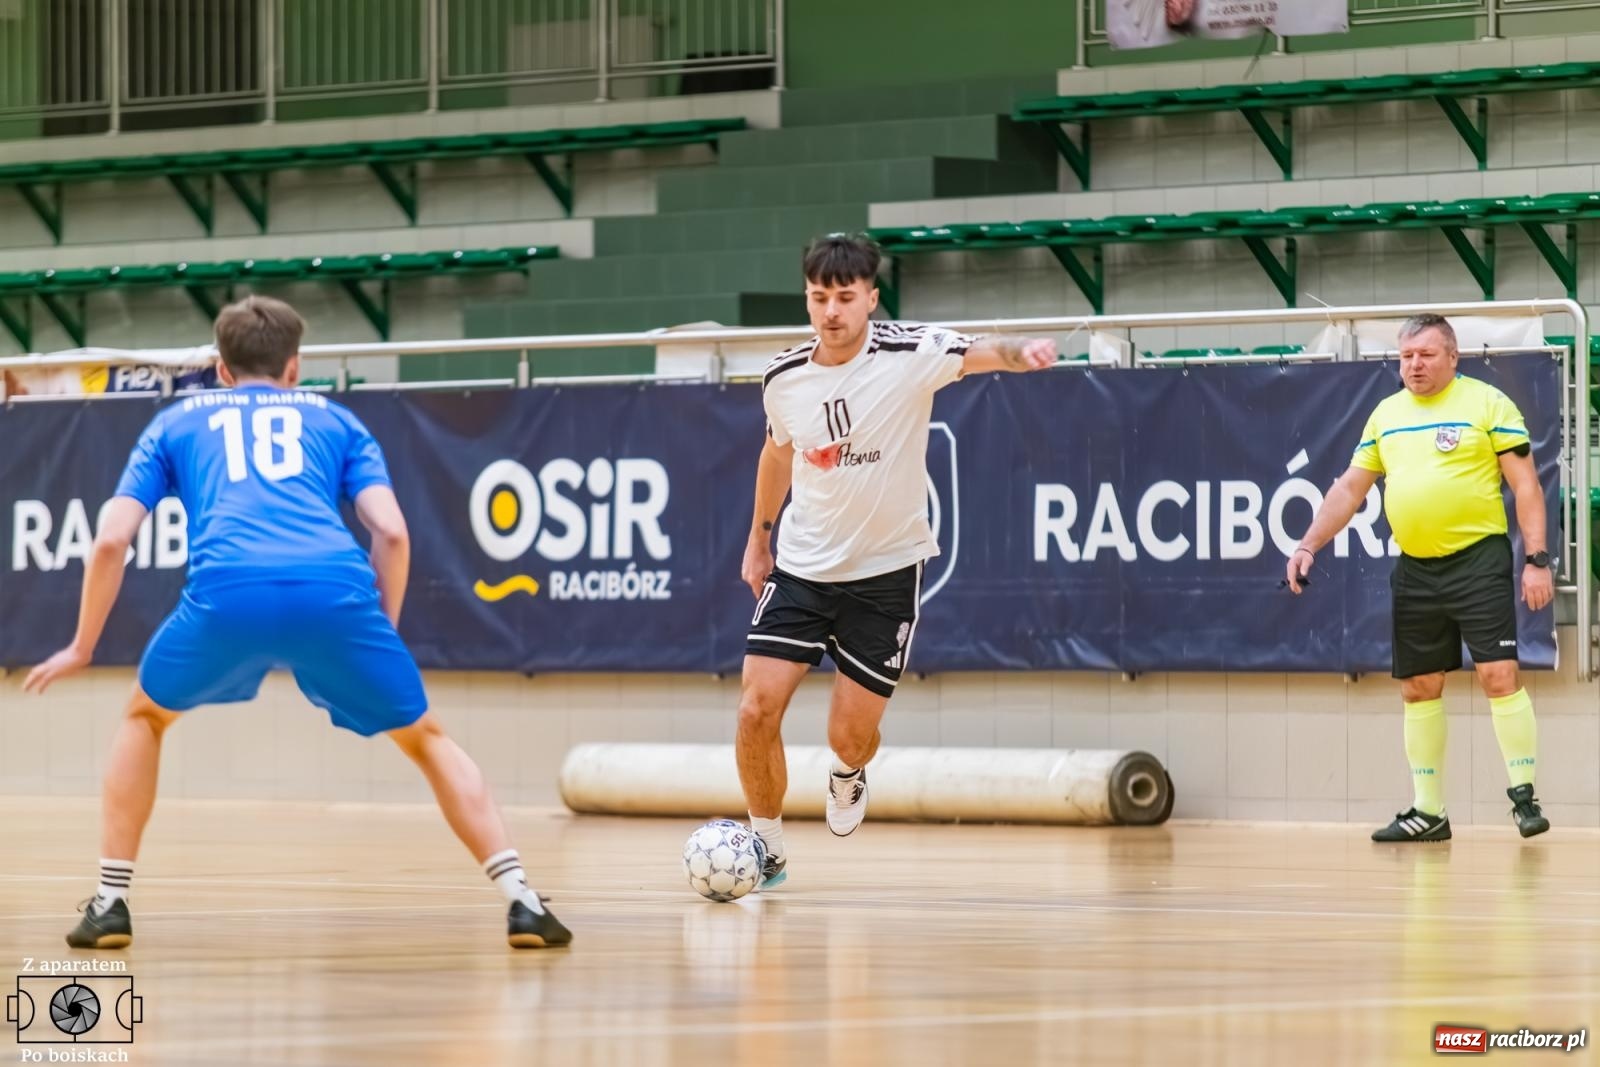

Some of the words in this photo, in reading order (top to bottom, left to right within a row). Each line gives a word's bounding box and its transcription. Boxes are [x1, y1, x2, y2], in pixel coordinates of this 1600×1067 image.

[207, 405, 304, 484] 18
[822, 398, 852, 442] 10
[1033, 448, 1402, 562] RACIBÓR
[549, 562, 672, 600] RACIBÓRZ
